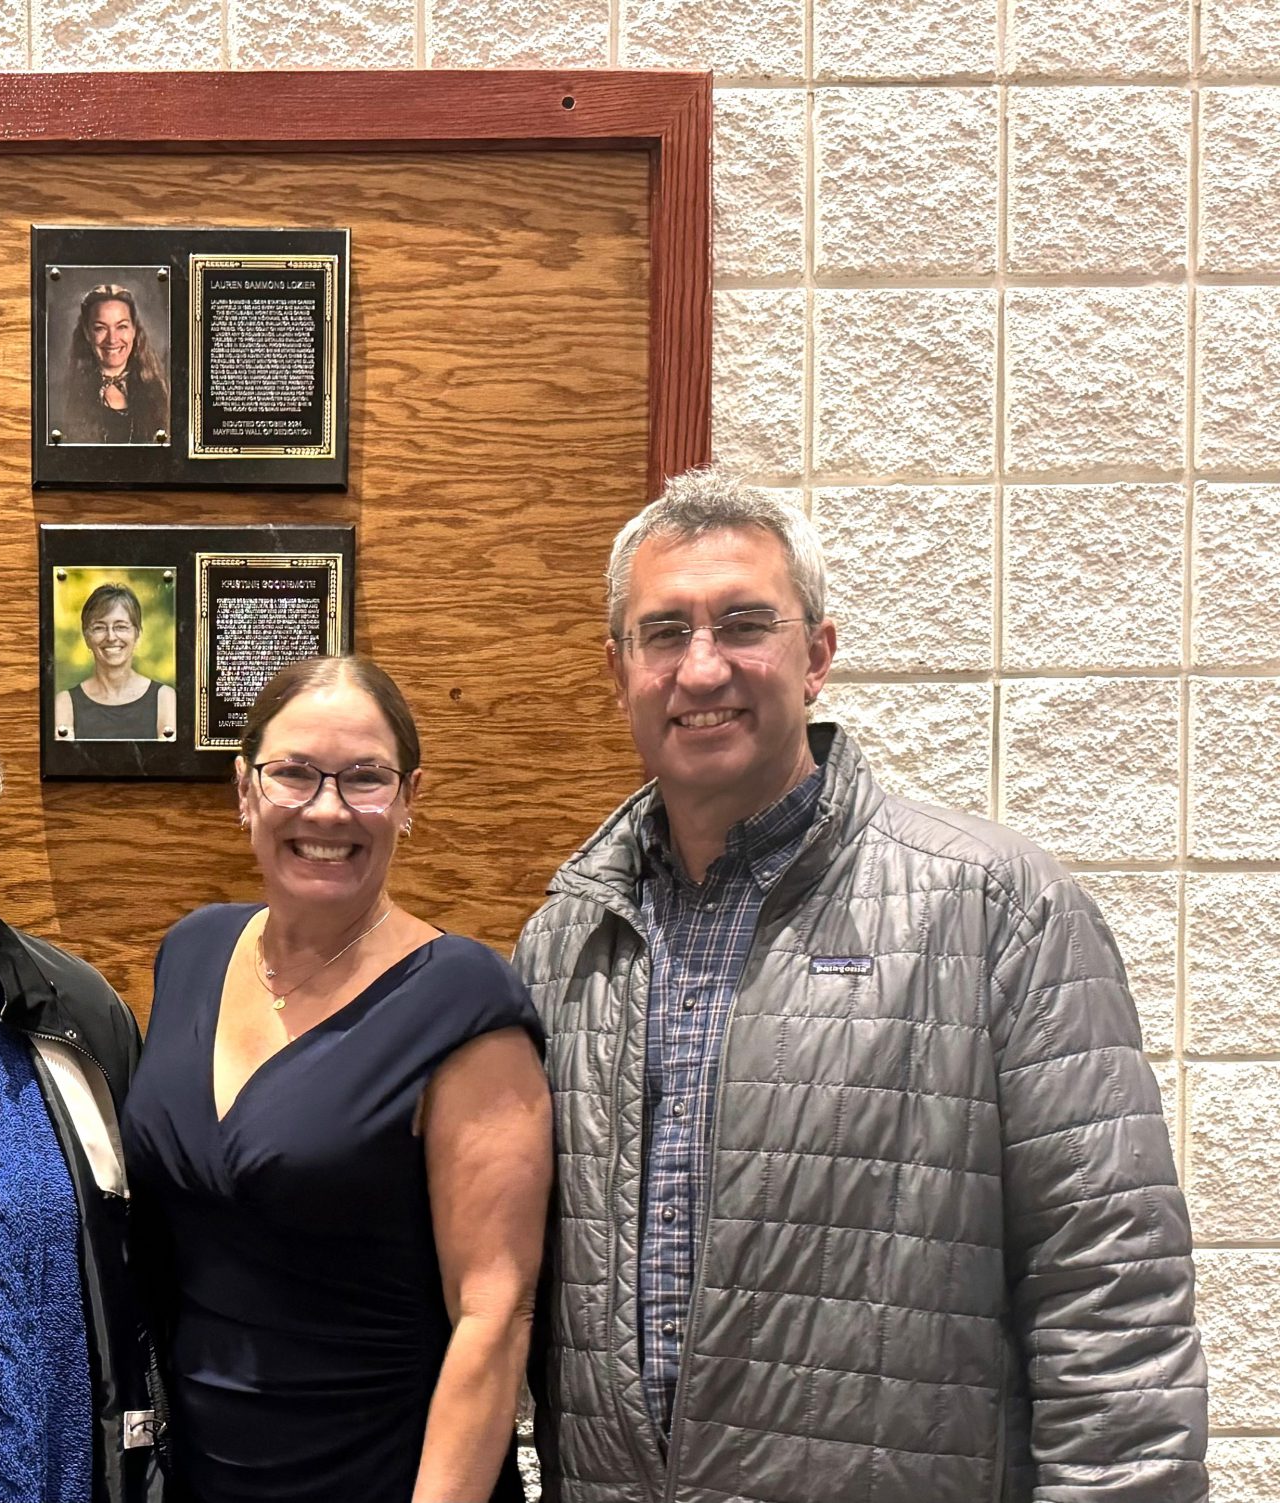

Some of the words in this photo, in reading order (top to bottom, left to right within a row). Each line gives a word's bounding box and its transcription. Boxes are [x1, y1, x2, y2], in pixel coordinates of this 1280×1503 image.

[210, 281, 243, 290] LAUREN
[244, 280, 285, 289] SAMMONS
[287, 280, 316, 289] LOZIER
[221, 580, 260, 589] KRISTINE
[228, 712, 248, 720] INDUC
